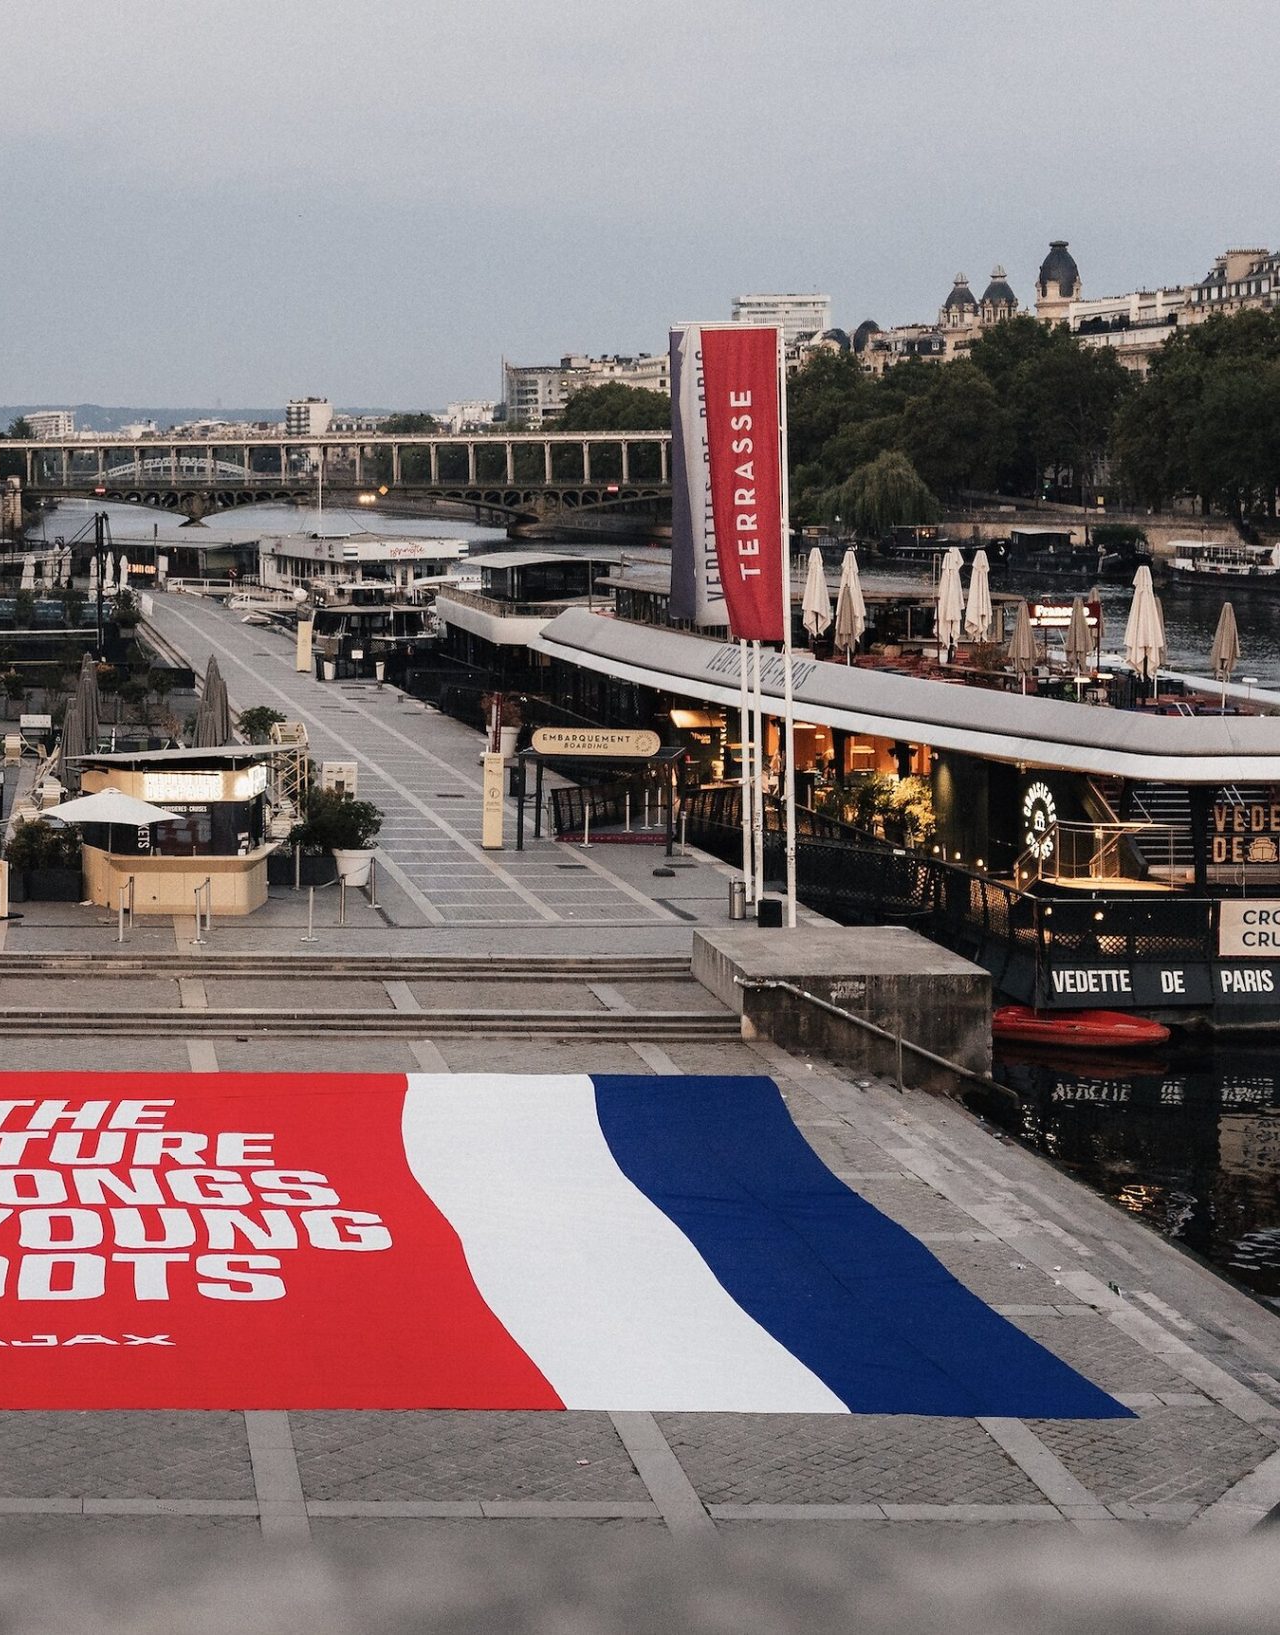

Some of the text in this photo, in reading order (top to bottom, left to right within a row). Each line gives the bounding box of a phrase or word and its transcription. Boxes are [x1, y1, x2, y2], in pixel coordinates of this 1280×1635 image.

[730, 391, 760, 580] TERRASSE
[542, 734, 631, 743] EMBARQUEMENT
[1213, 837, 1244, 863] DE
[1052, 970, 1274, 993] VEDETTE DE PARIS
